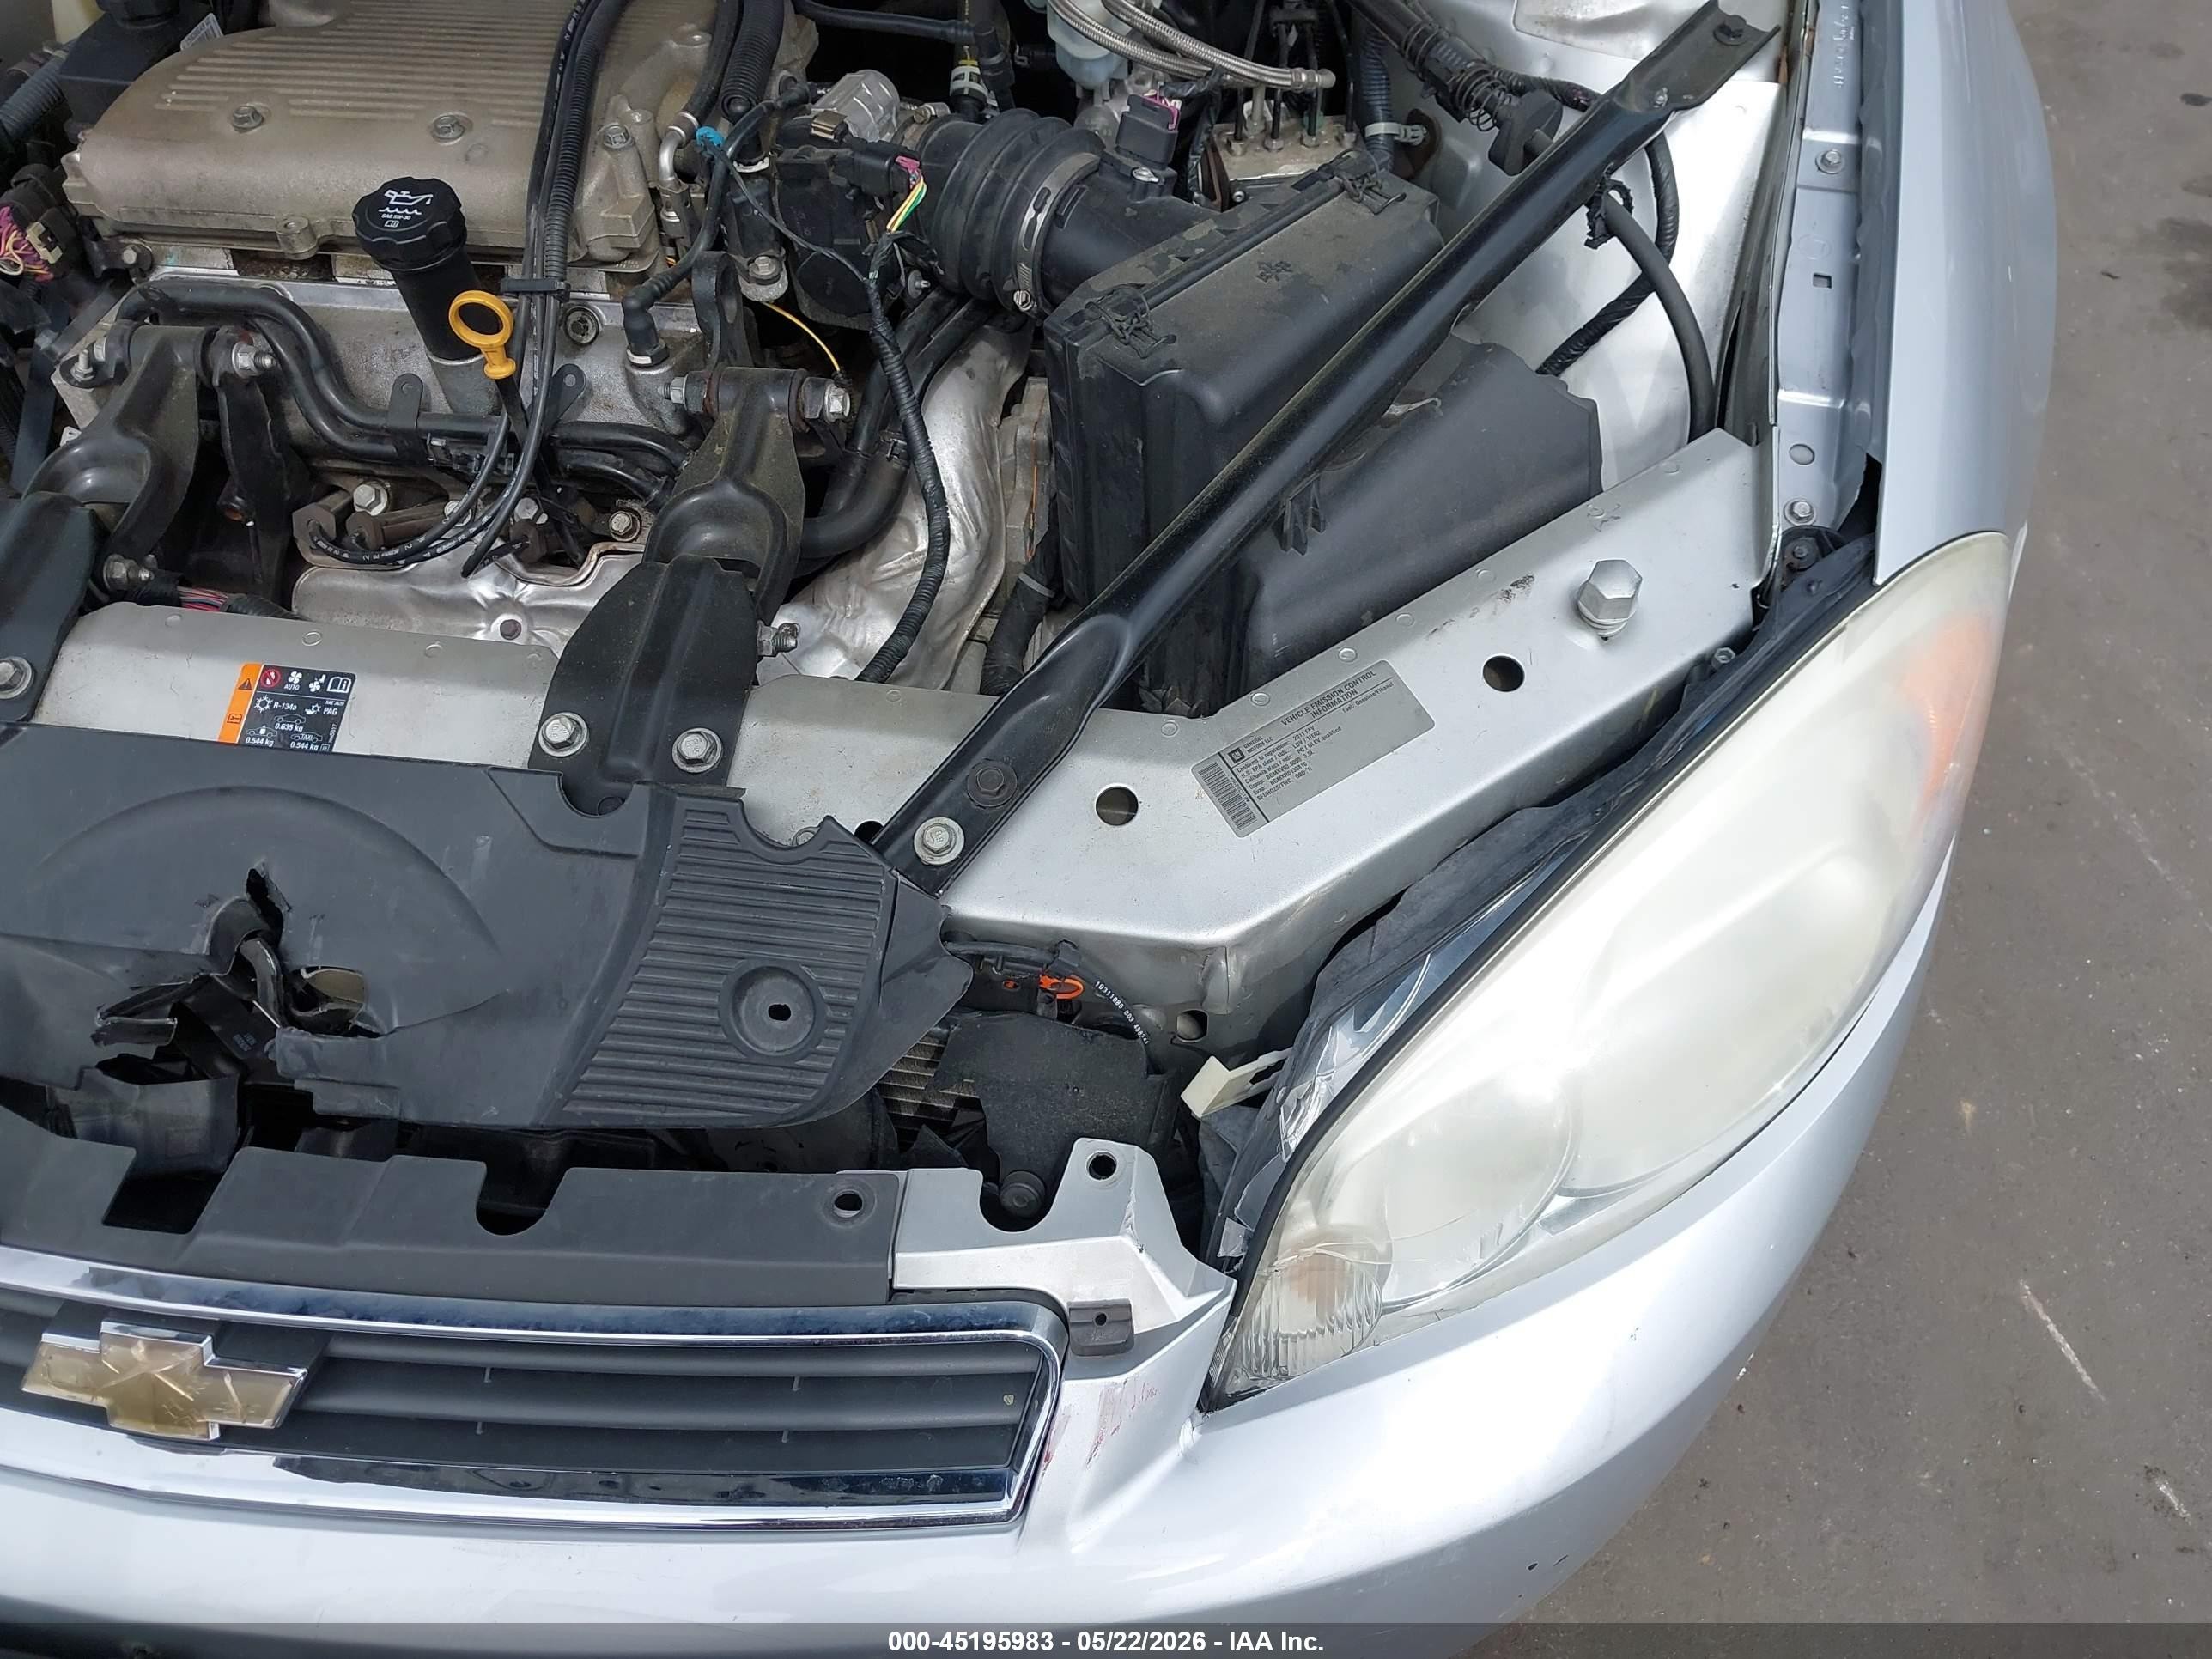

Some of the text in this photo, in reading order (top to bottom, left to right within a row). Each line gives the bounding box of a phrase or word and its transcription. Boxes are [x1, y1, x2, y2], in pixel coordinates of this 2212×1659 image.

[1281, 671, 1376, 726] VEHICLE EMISSION CONTROL
[1310, 690, 1358, 718] INFORMATION
